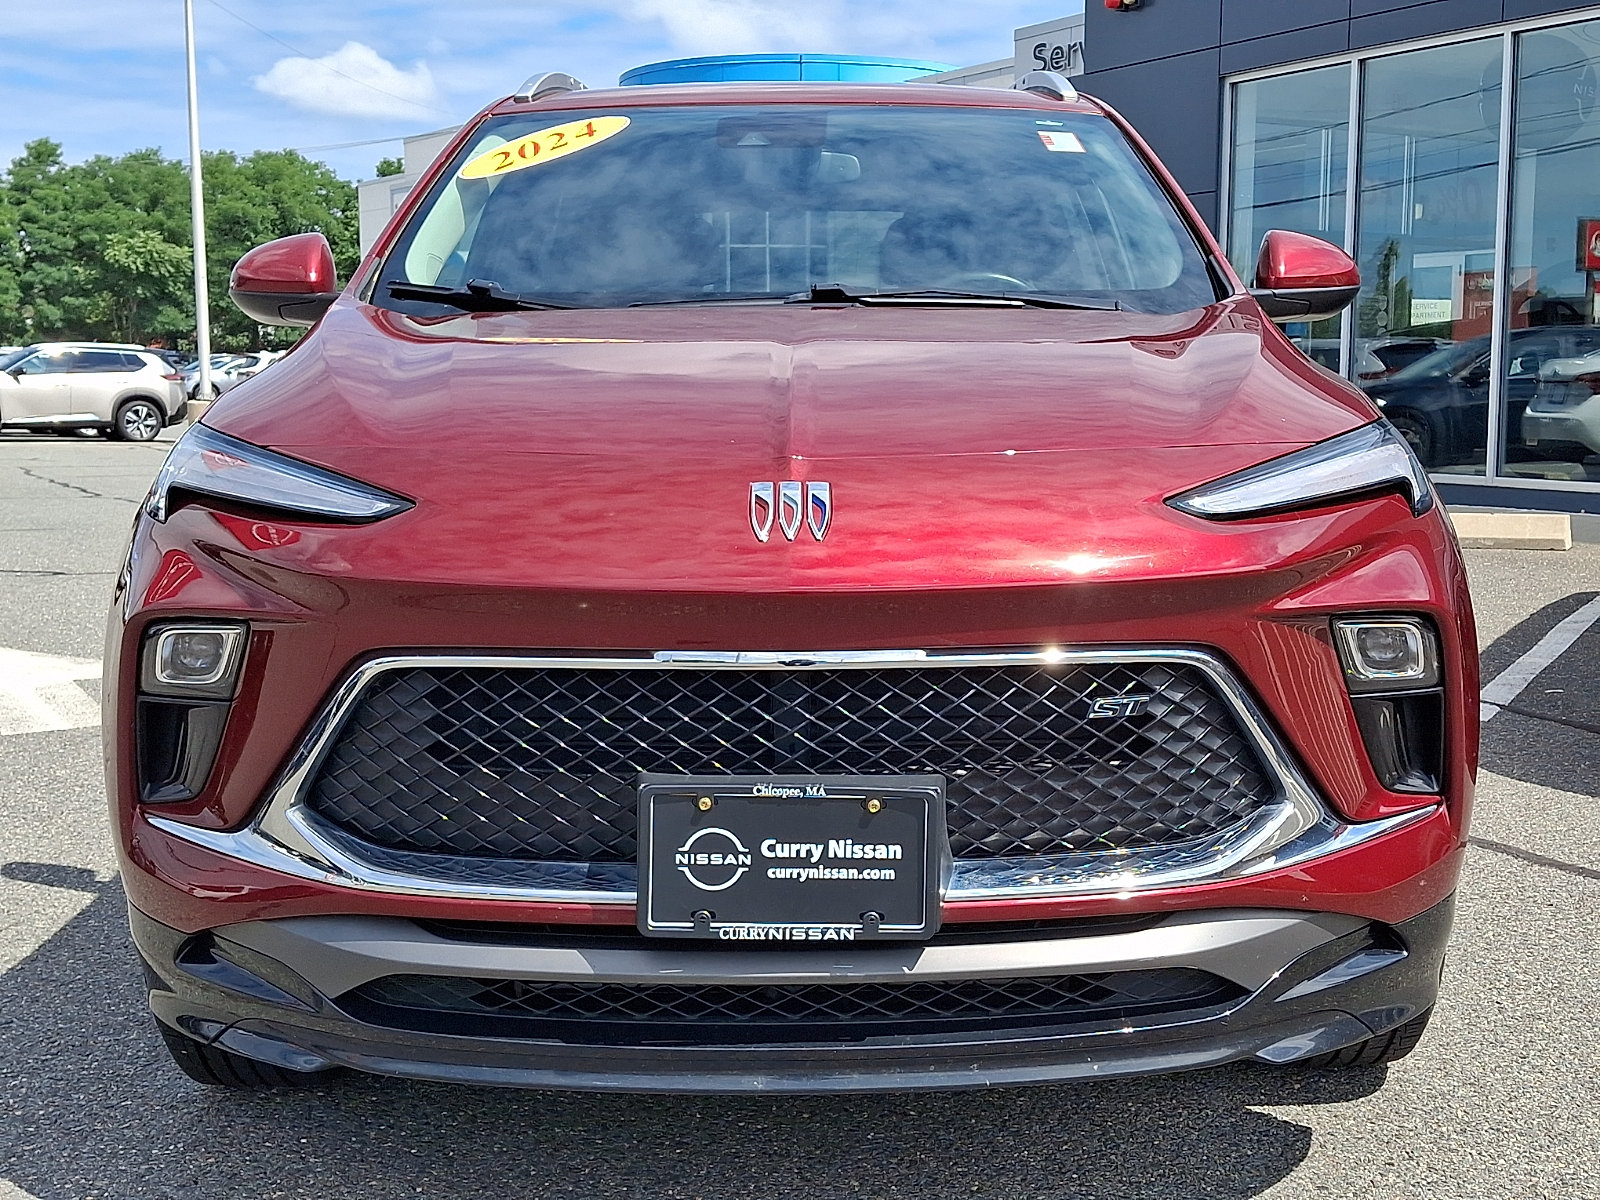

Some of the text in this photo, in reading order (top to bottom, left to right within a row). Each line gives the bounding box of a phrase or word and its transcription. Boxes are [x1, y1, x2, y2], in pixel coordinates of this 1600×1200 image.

[491, 121, 597, 171] 2024
[1088, 695, 1150, 719] ST
[805, 786, 827, 797] MA
[675, 852, 752, 866] NISSAN
[760, 838, 902, 864] Curry Nissan
[766, 866, 896, 882] currynissan.com
